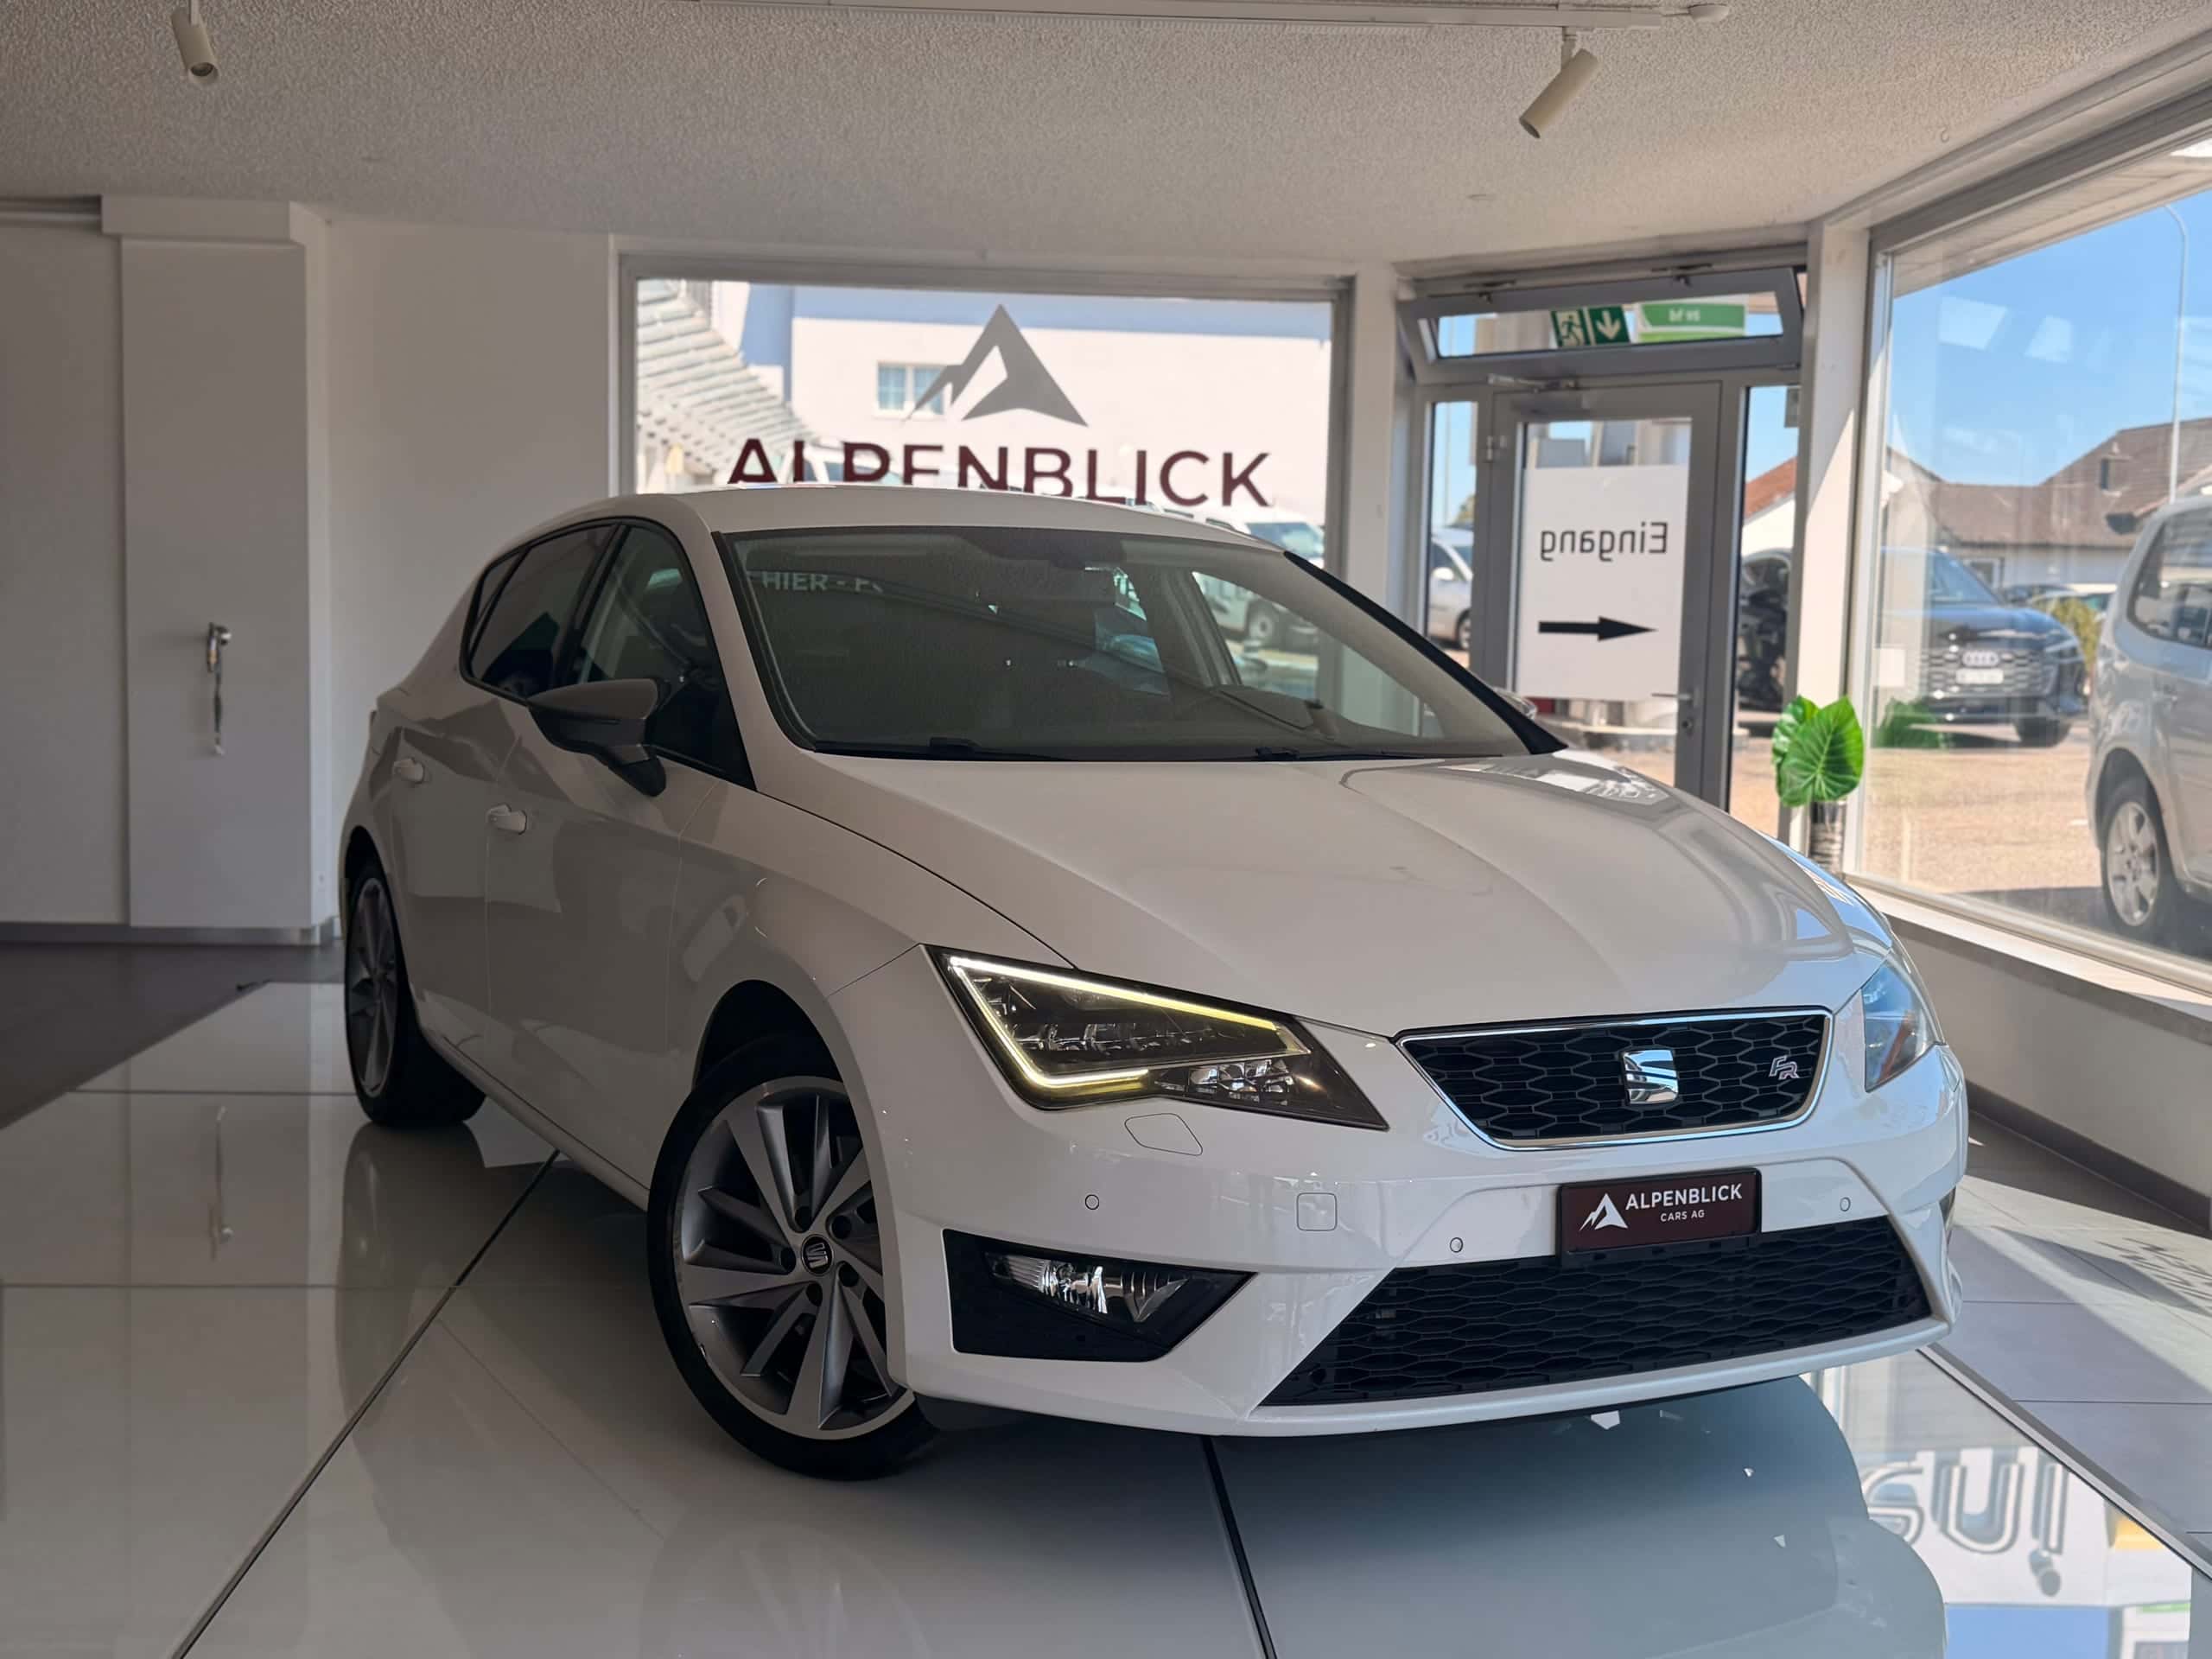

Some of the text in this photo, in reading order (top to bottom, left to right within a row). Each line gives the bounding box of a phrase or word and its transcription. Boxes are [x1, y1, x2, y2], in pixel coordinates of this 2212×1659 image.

[728, 438, 1269, 507] ALPENBLICK
[761, 570, 830, 592] HIER
[1624, 1183, 1743, 1211] ALPENBLICK
[1660, 1210, 1706, 1223] CARS AG
